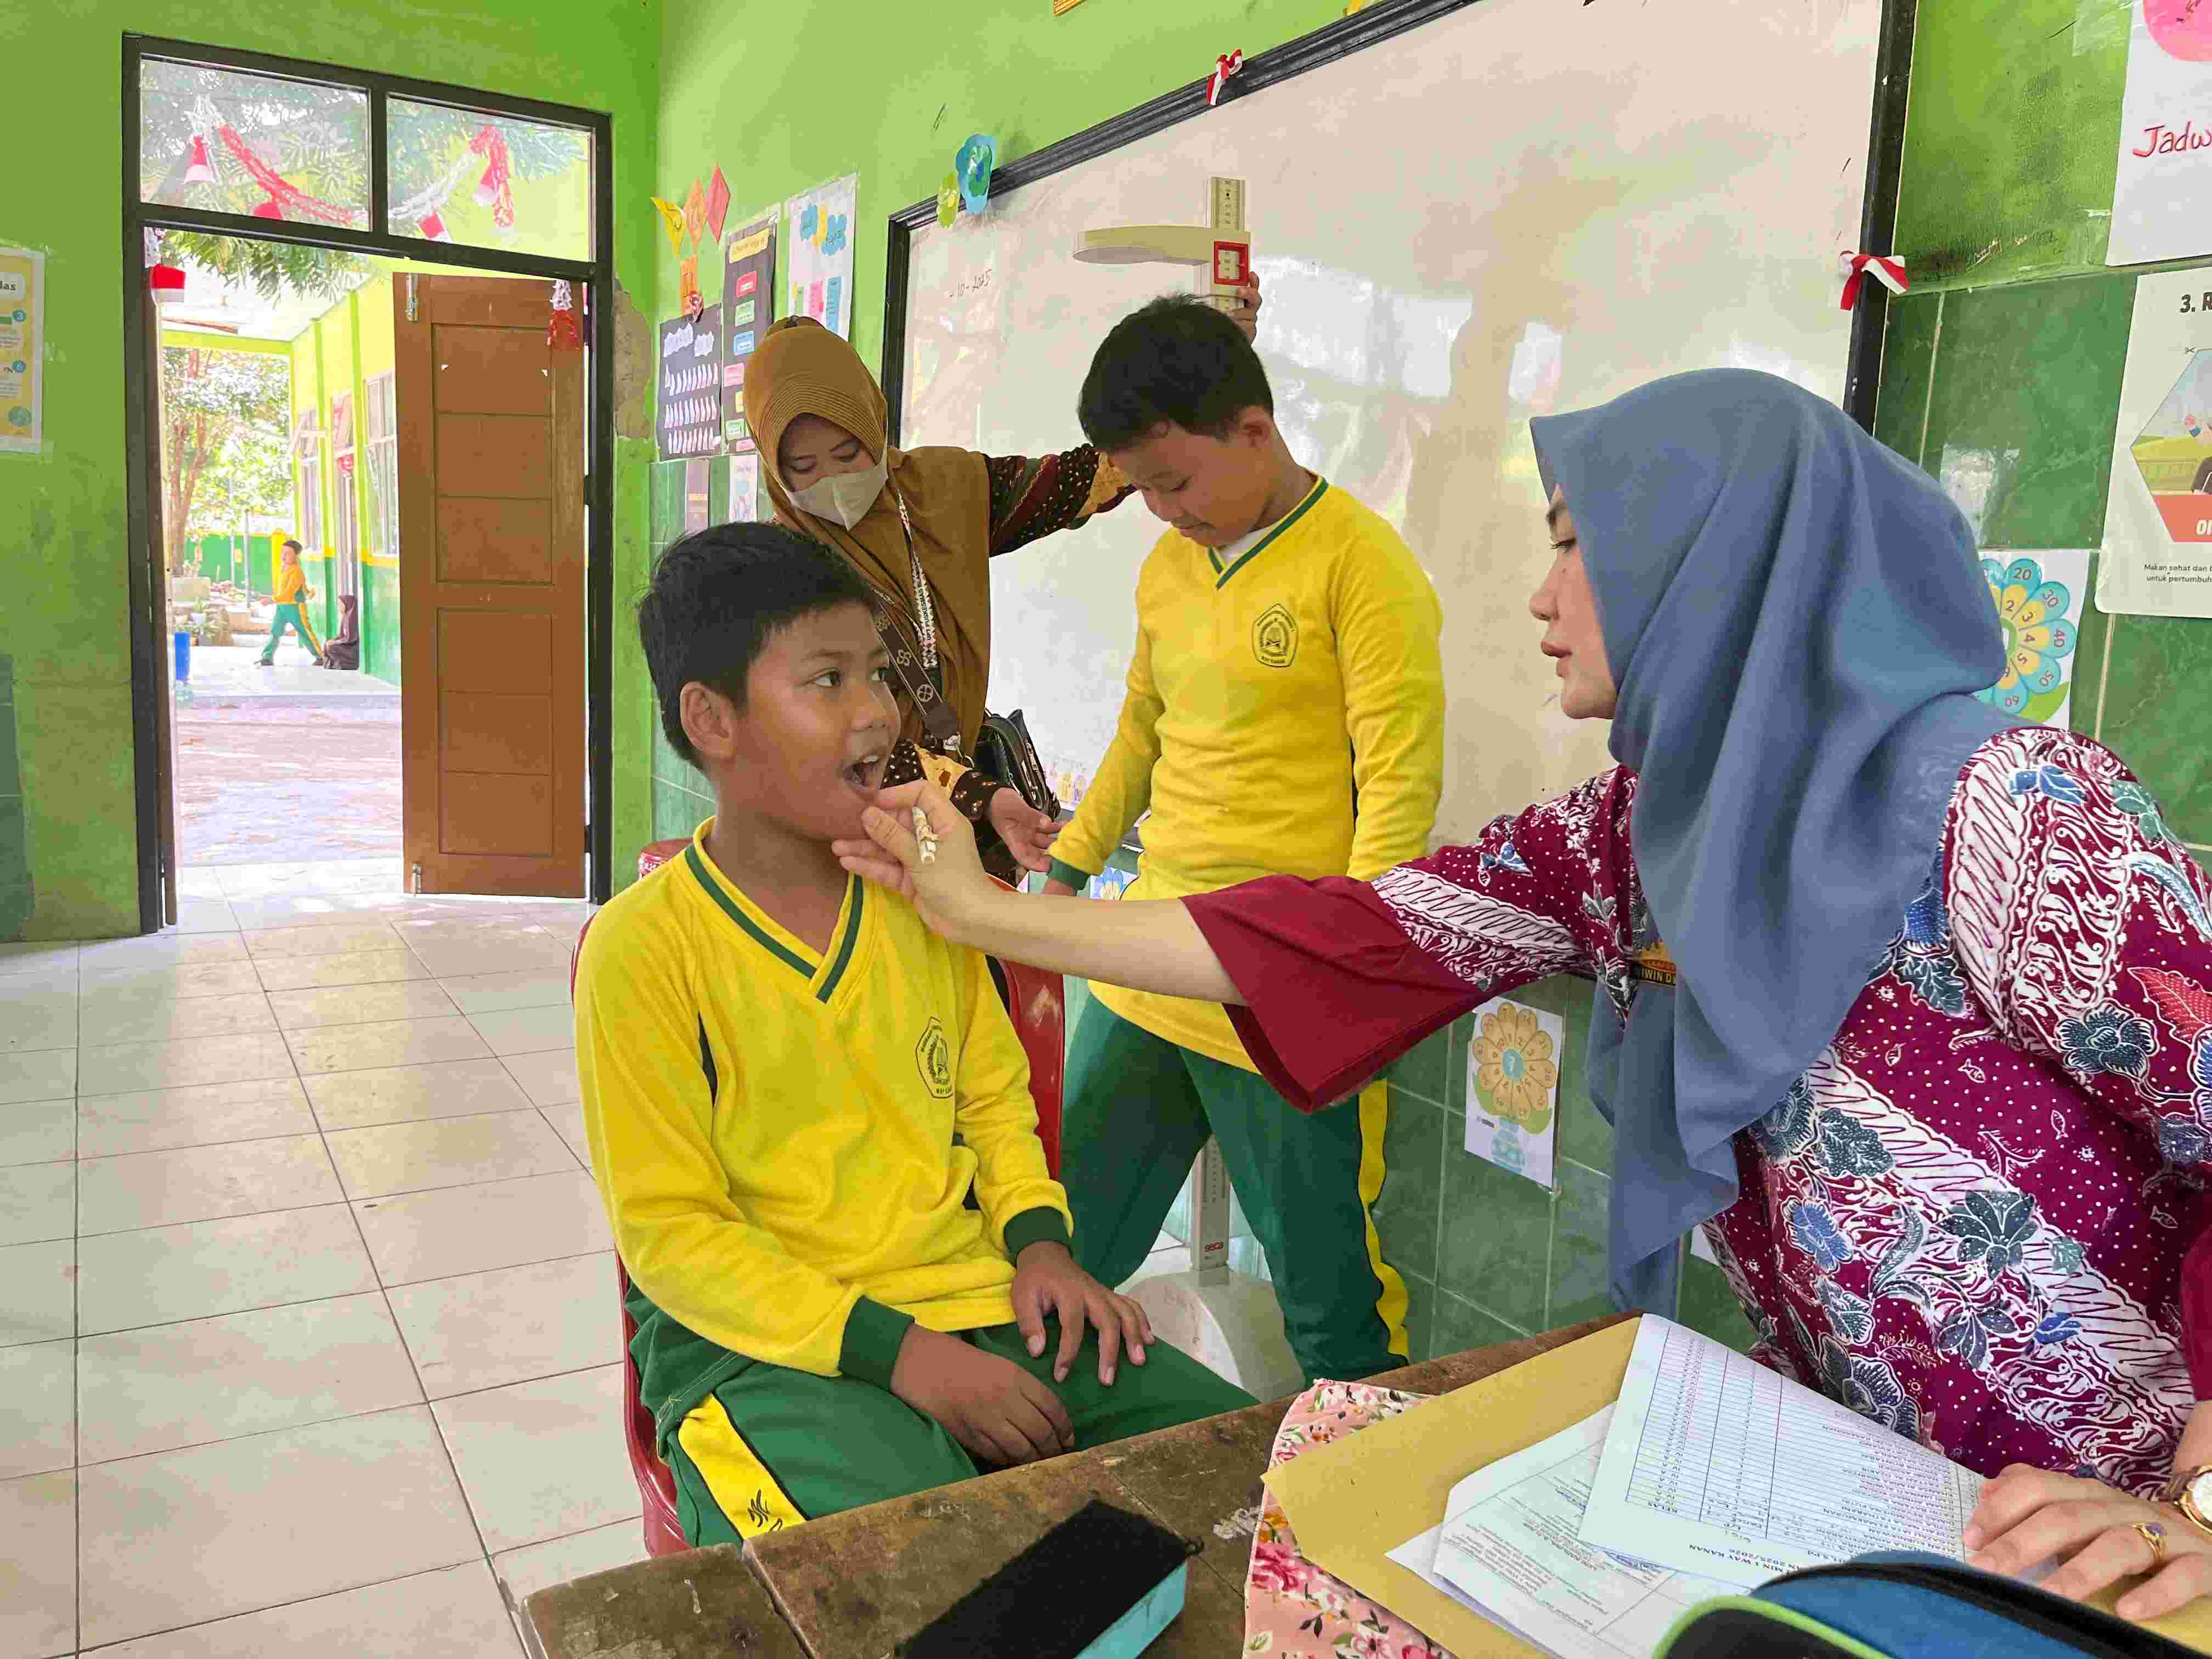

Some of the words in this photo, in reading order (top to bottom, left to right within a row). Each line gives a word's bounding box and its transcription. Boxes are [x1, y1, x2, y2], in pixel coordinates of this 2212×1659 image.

[2180, 294, 2196, 313] 3.
[2013, 567, 2032, 580] 20
[2042, 589, 2059, 607] 30
[918, 588, 930, 627] PUSKESMAS
[2006, 600, 2014, 612] 2
[2022, 612, 2033, 622] 3
[2024, 633, 2035, 642] 4
[2054, 630, 2065, 648] 40
[1646, 1501, 1678, 1514] KELAS
[1688, 1544, 1725, 1558] KANAN
[1726, 1554, 1752, 1565] WAY
